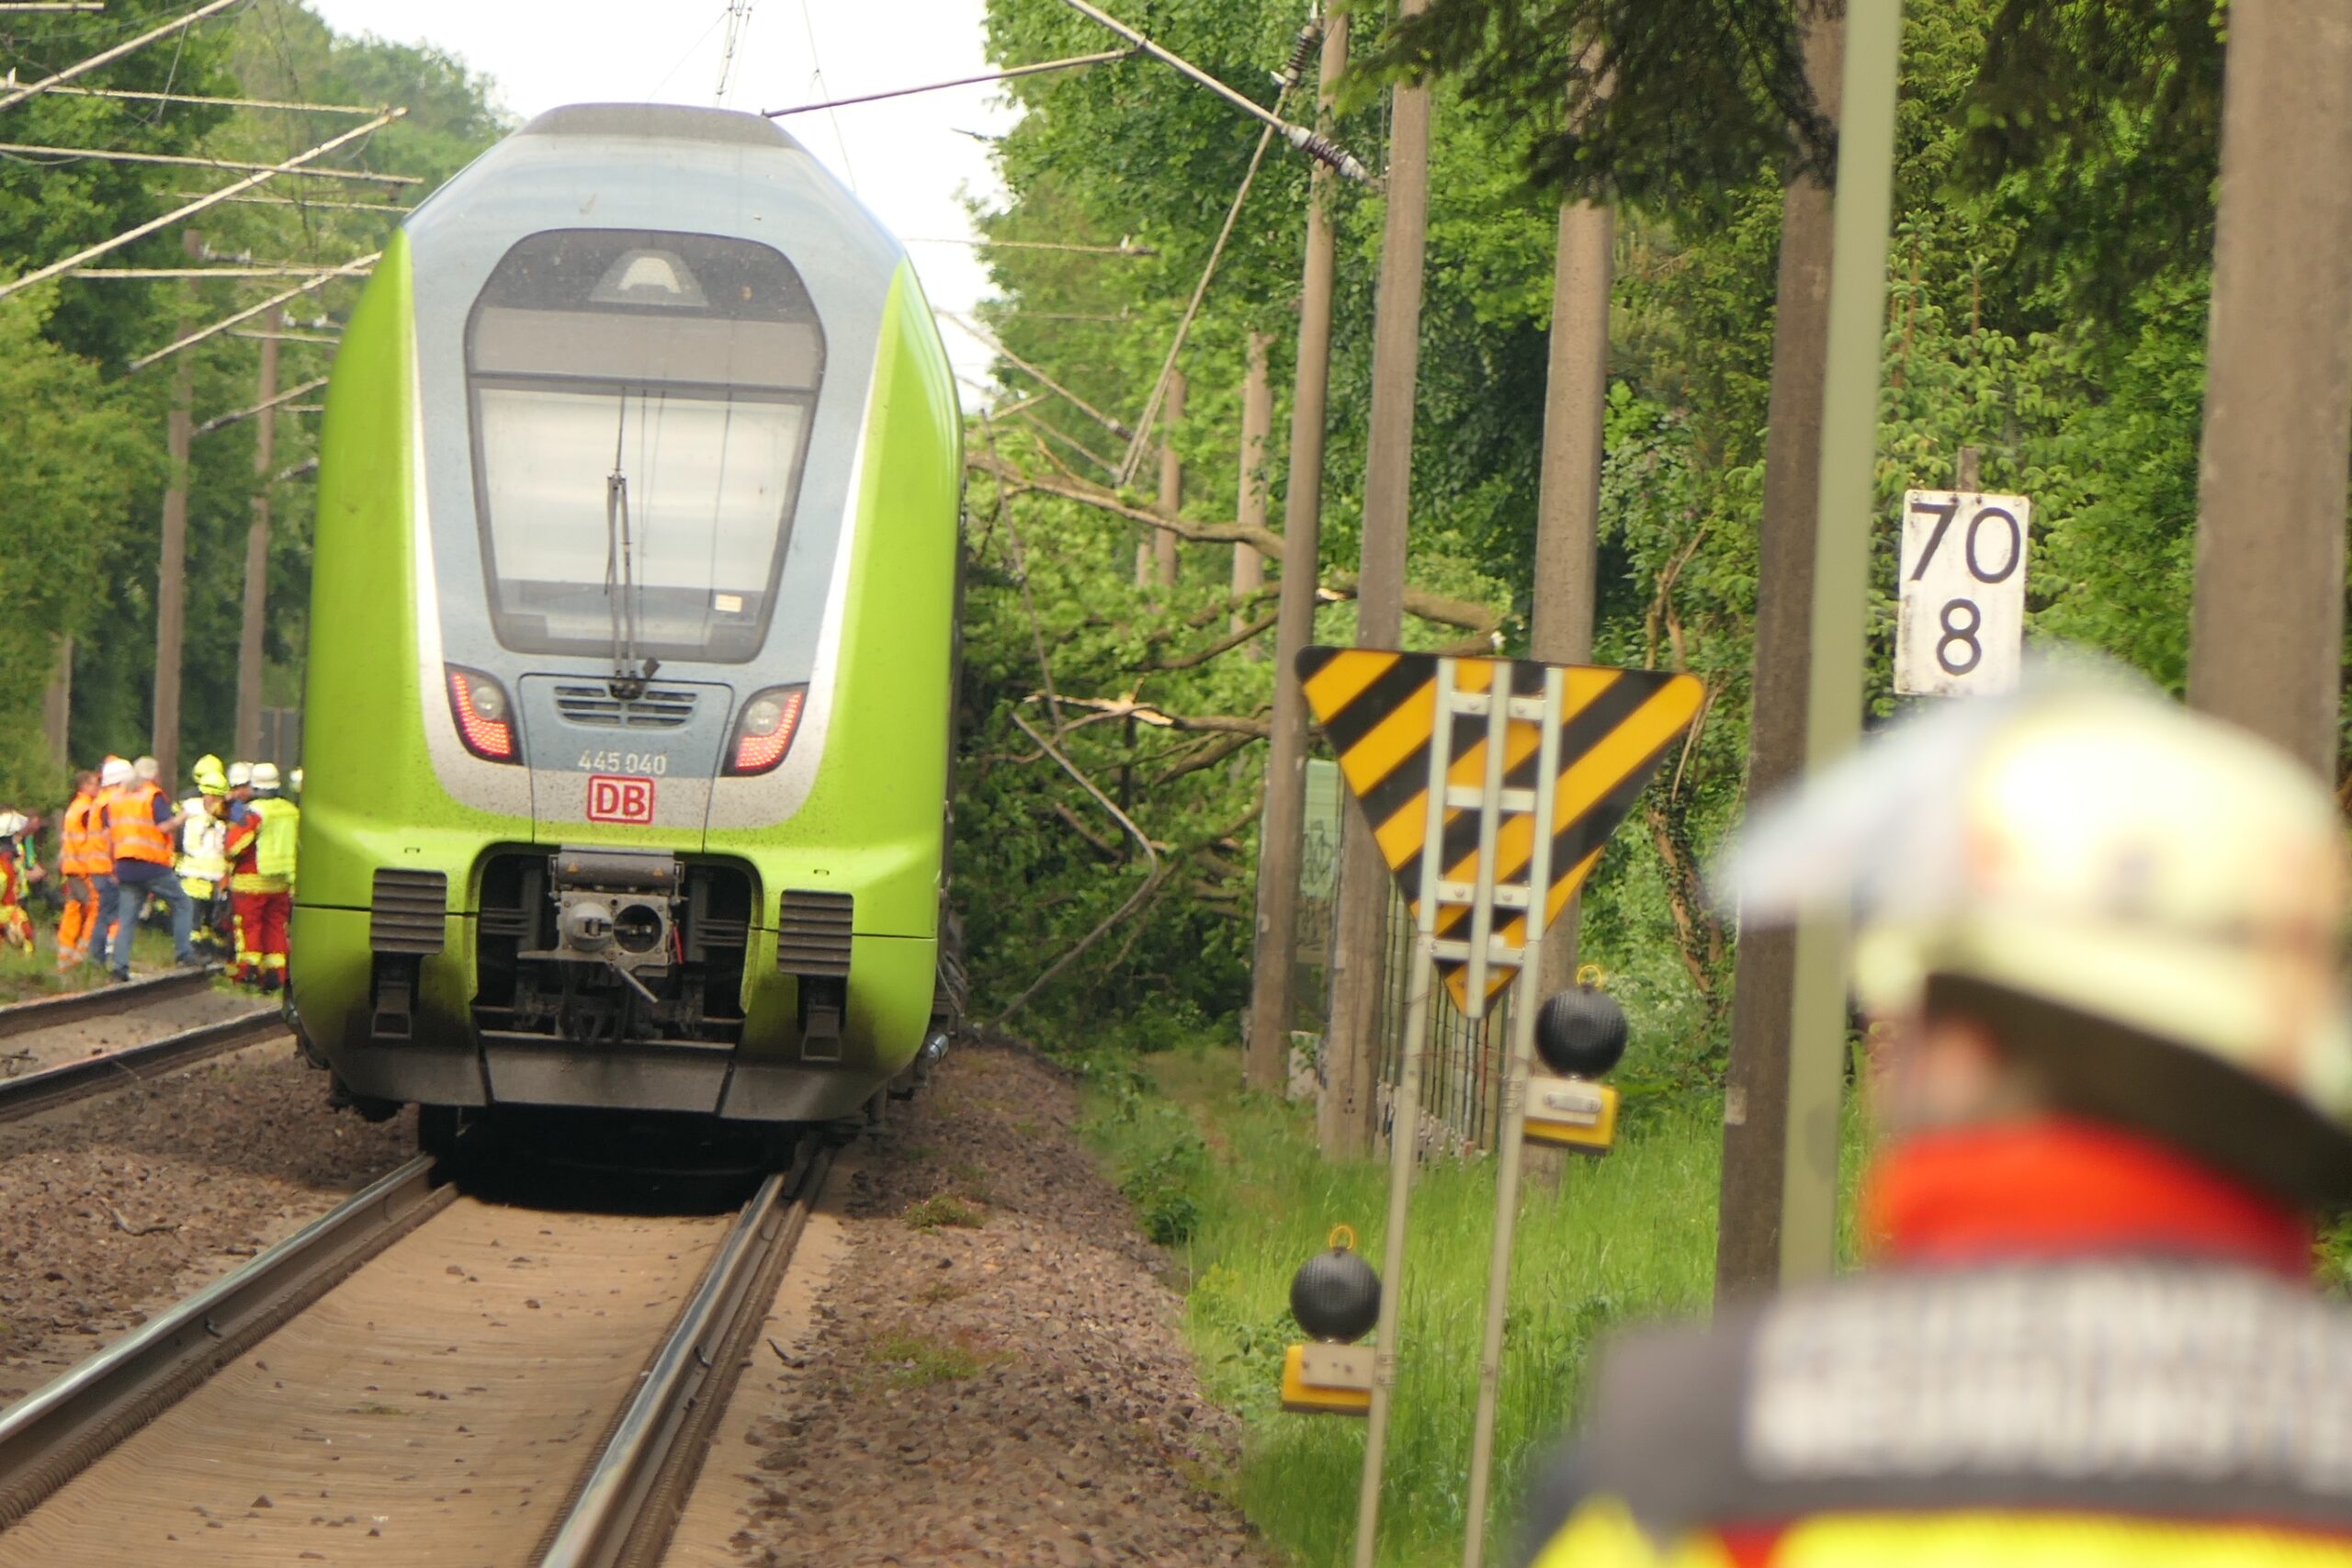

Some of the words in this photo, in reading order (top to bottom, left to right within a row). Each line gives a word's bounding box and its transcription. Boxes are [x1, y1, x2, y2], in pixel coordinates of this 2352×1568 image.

[1911, 502, 2020, 583] 70
[1937, 598, 1982, 676] 8
[578, 750, 620, 773] 445
[626, 753, 667, 774] 040
[596, 784, 646, 816] DB
